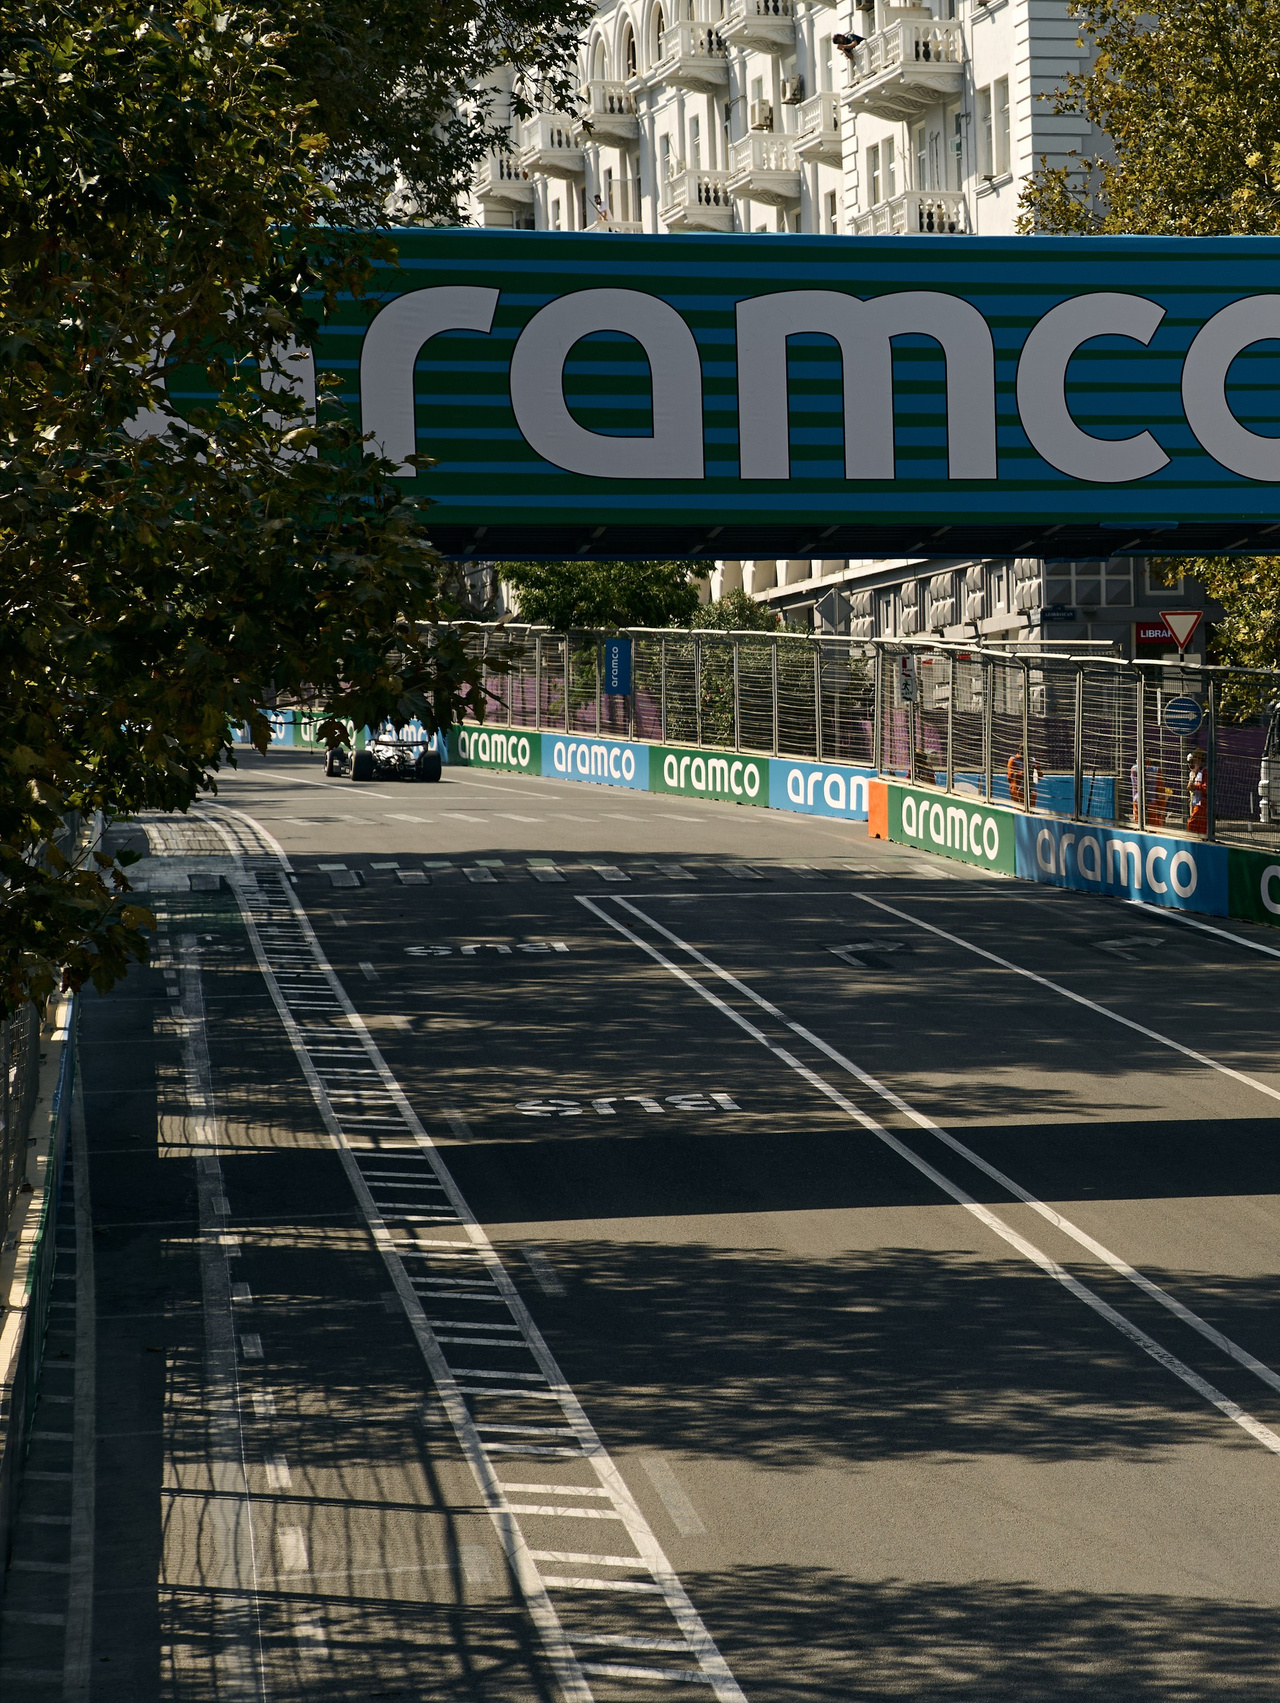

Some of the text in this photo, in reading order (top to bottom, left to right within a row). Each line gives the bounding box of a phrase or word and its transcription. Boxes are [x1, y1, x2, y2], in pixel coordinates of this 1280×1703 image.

[611, 646, 619, 687] aramco
[458, 730, 530, 767] aramco
[553, 741, 636, 781] aramco
[663, 754, 761, 798] aramco
[901, 796, 999, 860] aramco
[1036, 828, 1198, 898] aramco
